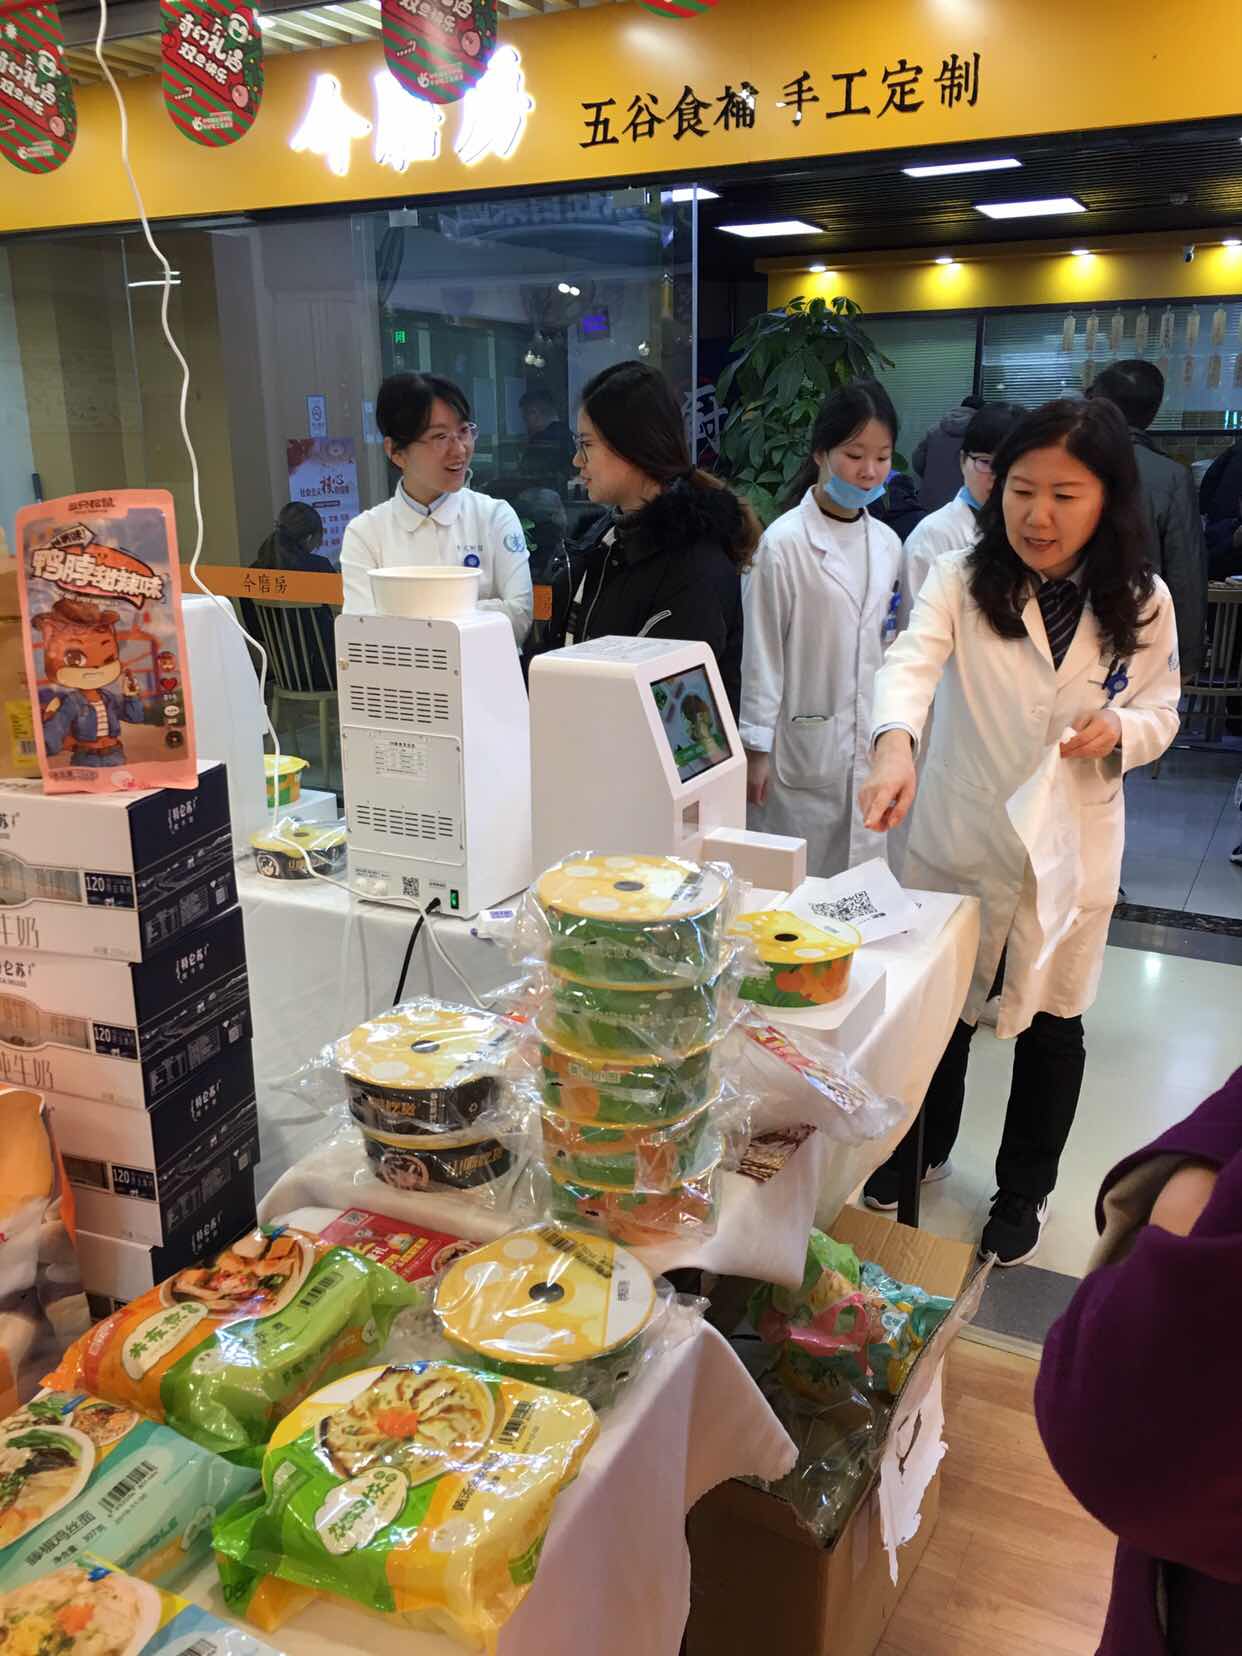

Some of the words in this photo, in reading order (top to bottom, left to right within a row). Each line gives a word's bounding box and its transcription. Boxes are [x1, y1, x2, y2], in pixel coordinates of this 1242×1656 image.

[777, 52, 981, 126] 手工定制
[31, 547, 164, 600] 鸭脖甜辣味
[243, 573, 288, 594] 今磨房
[86, 876, 105, 892] 120
[94, 1026, 111, 1043] 120
[112, 1168, 130, 1184] 120
